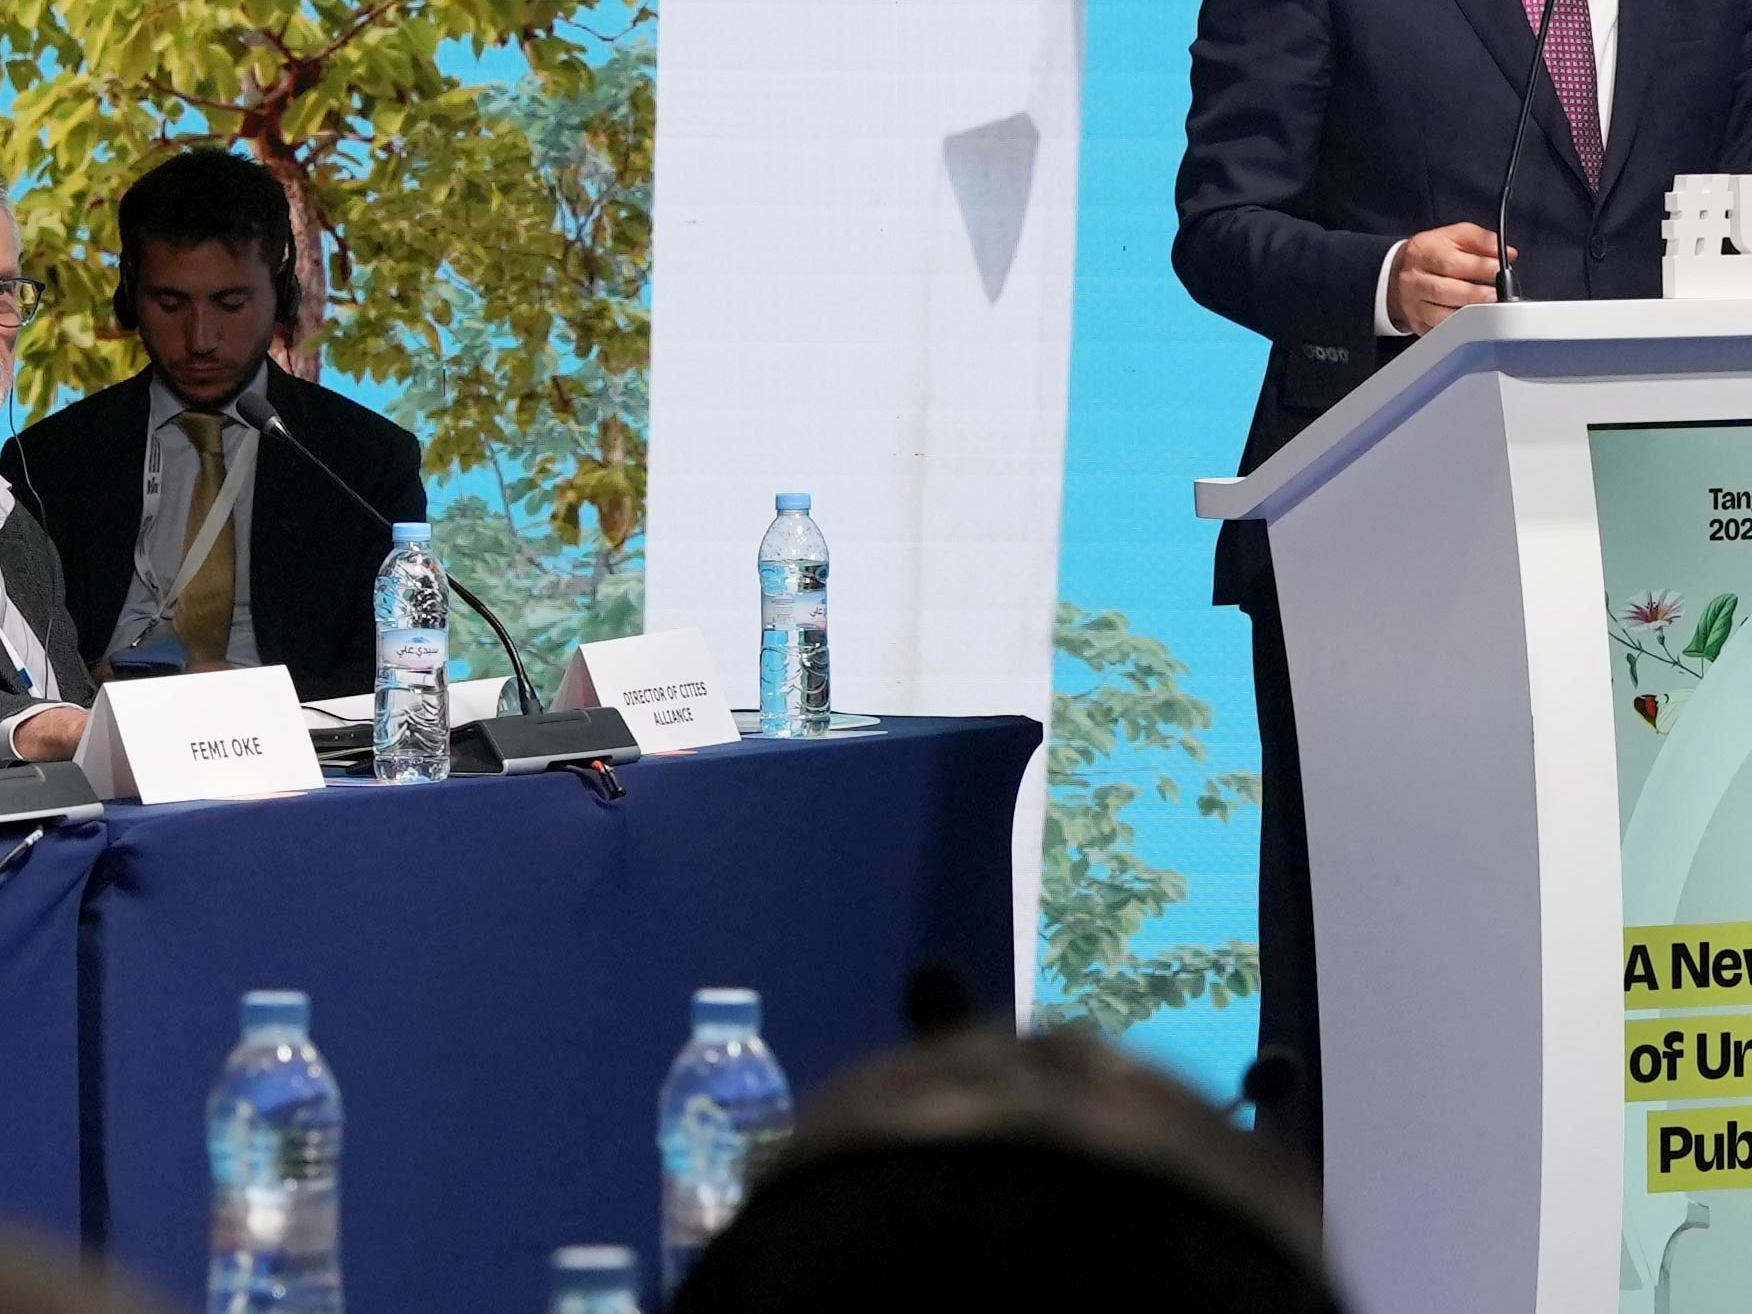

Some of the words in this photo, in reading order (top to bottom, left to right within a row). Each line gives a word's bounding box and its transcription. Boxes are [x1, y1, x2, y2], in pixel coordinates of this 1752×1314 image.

[622, 686, 667, 706] DIRECTOR
[666, 684, 678, 701] OF
[679, 681, 708, 699] CITIES
[653, 707, 694, 726] ALLIANCE
[190, 739, 229, 761] FEMI
[231, 736, 263, 757] OKE
[1624, 944, 1659, 993] A
[1629, 1030, 1685, 1084] of
